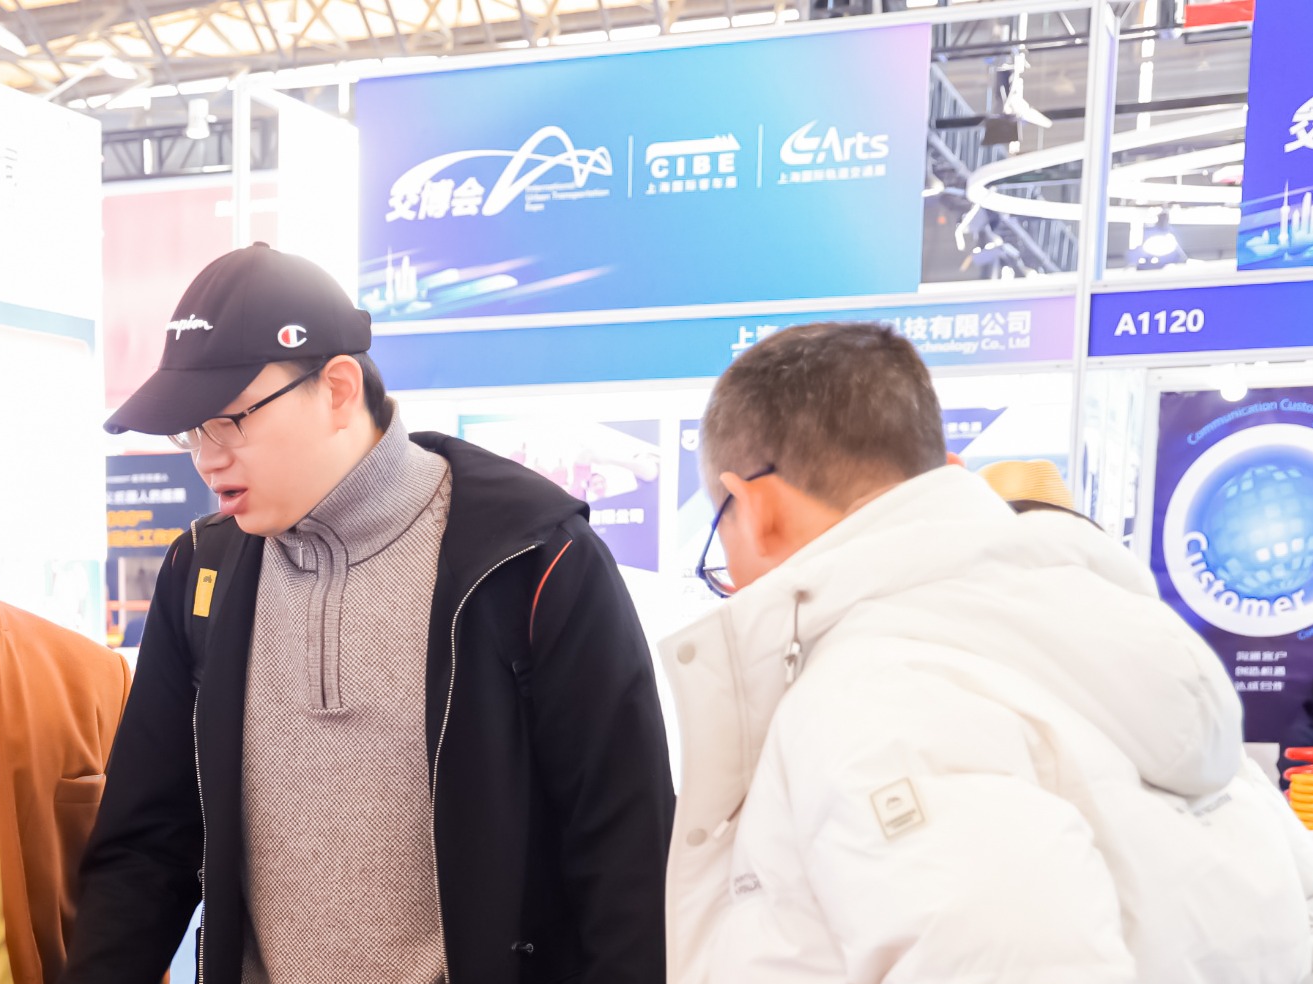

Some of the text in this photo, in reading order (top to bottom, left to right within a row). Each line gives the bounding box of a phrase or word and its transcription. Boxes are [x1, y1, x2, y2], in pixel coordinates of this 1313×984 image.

[650, 152, 735, 179] CIBE
[1114, 309, 1205, 337] A1120
[1187, 401, 1277, 446] Communication
[1184, 531, 1305, 617] Customer
